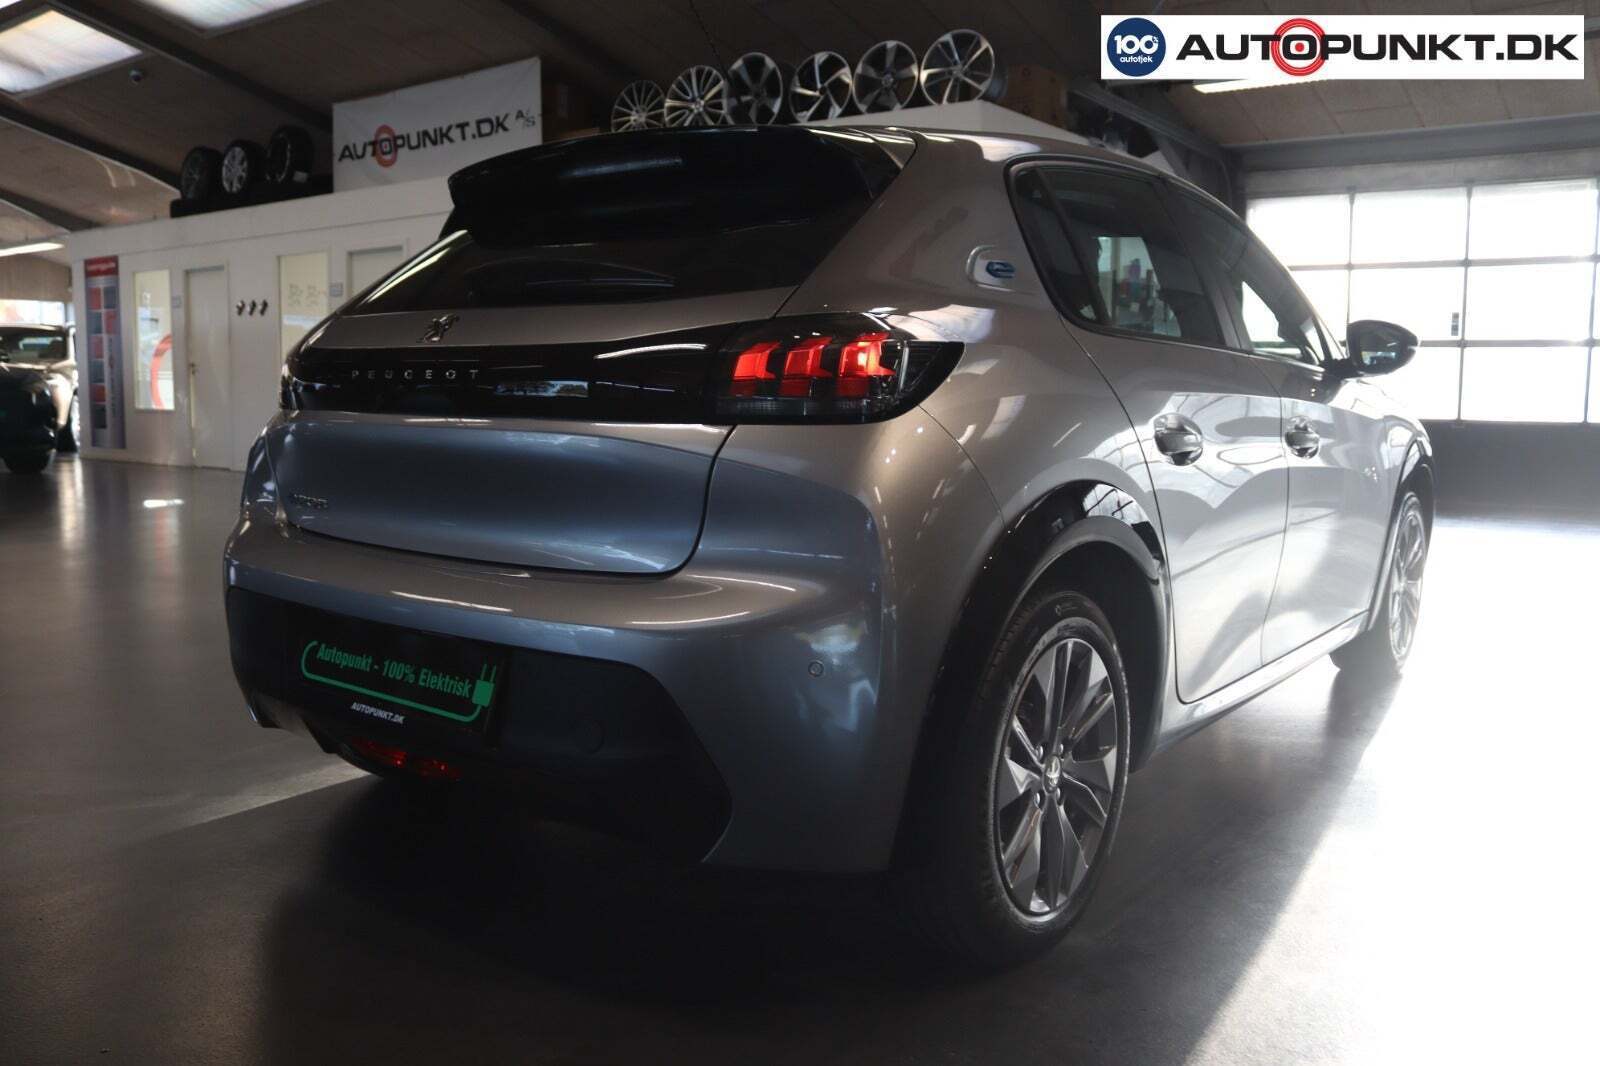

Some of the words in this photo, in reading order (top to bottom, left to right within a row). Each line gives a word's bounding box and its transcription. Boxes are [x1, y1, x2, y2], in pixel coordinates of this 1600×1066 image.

[337, 113, 510, 163] AUTOPUNKT.DK
[351, 369, 479, 380] PEUGEOT
[316, 643, 373, 672] Autopunkt
[382, 659, 416, 684] 100%
[418, 668, 473, 699] Elektrisk
[350, 701, 406, 725] AUTOPUNKT.DK
